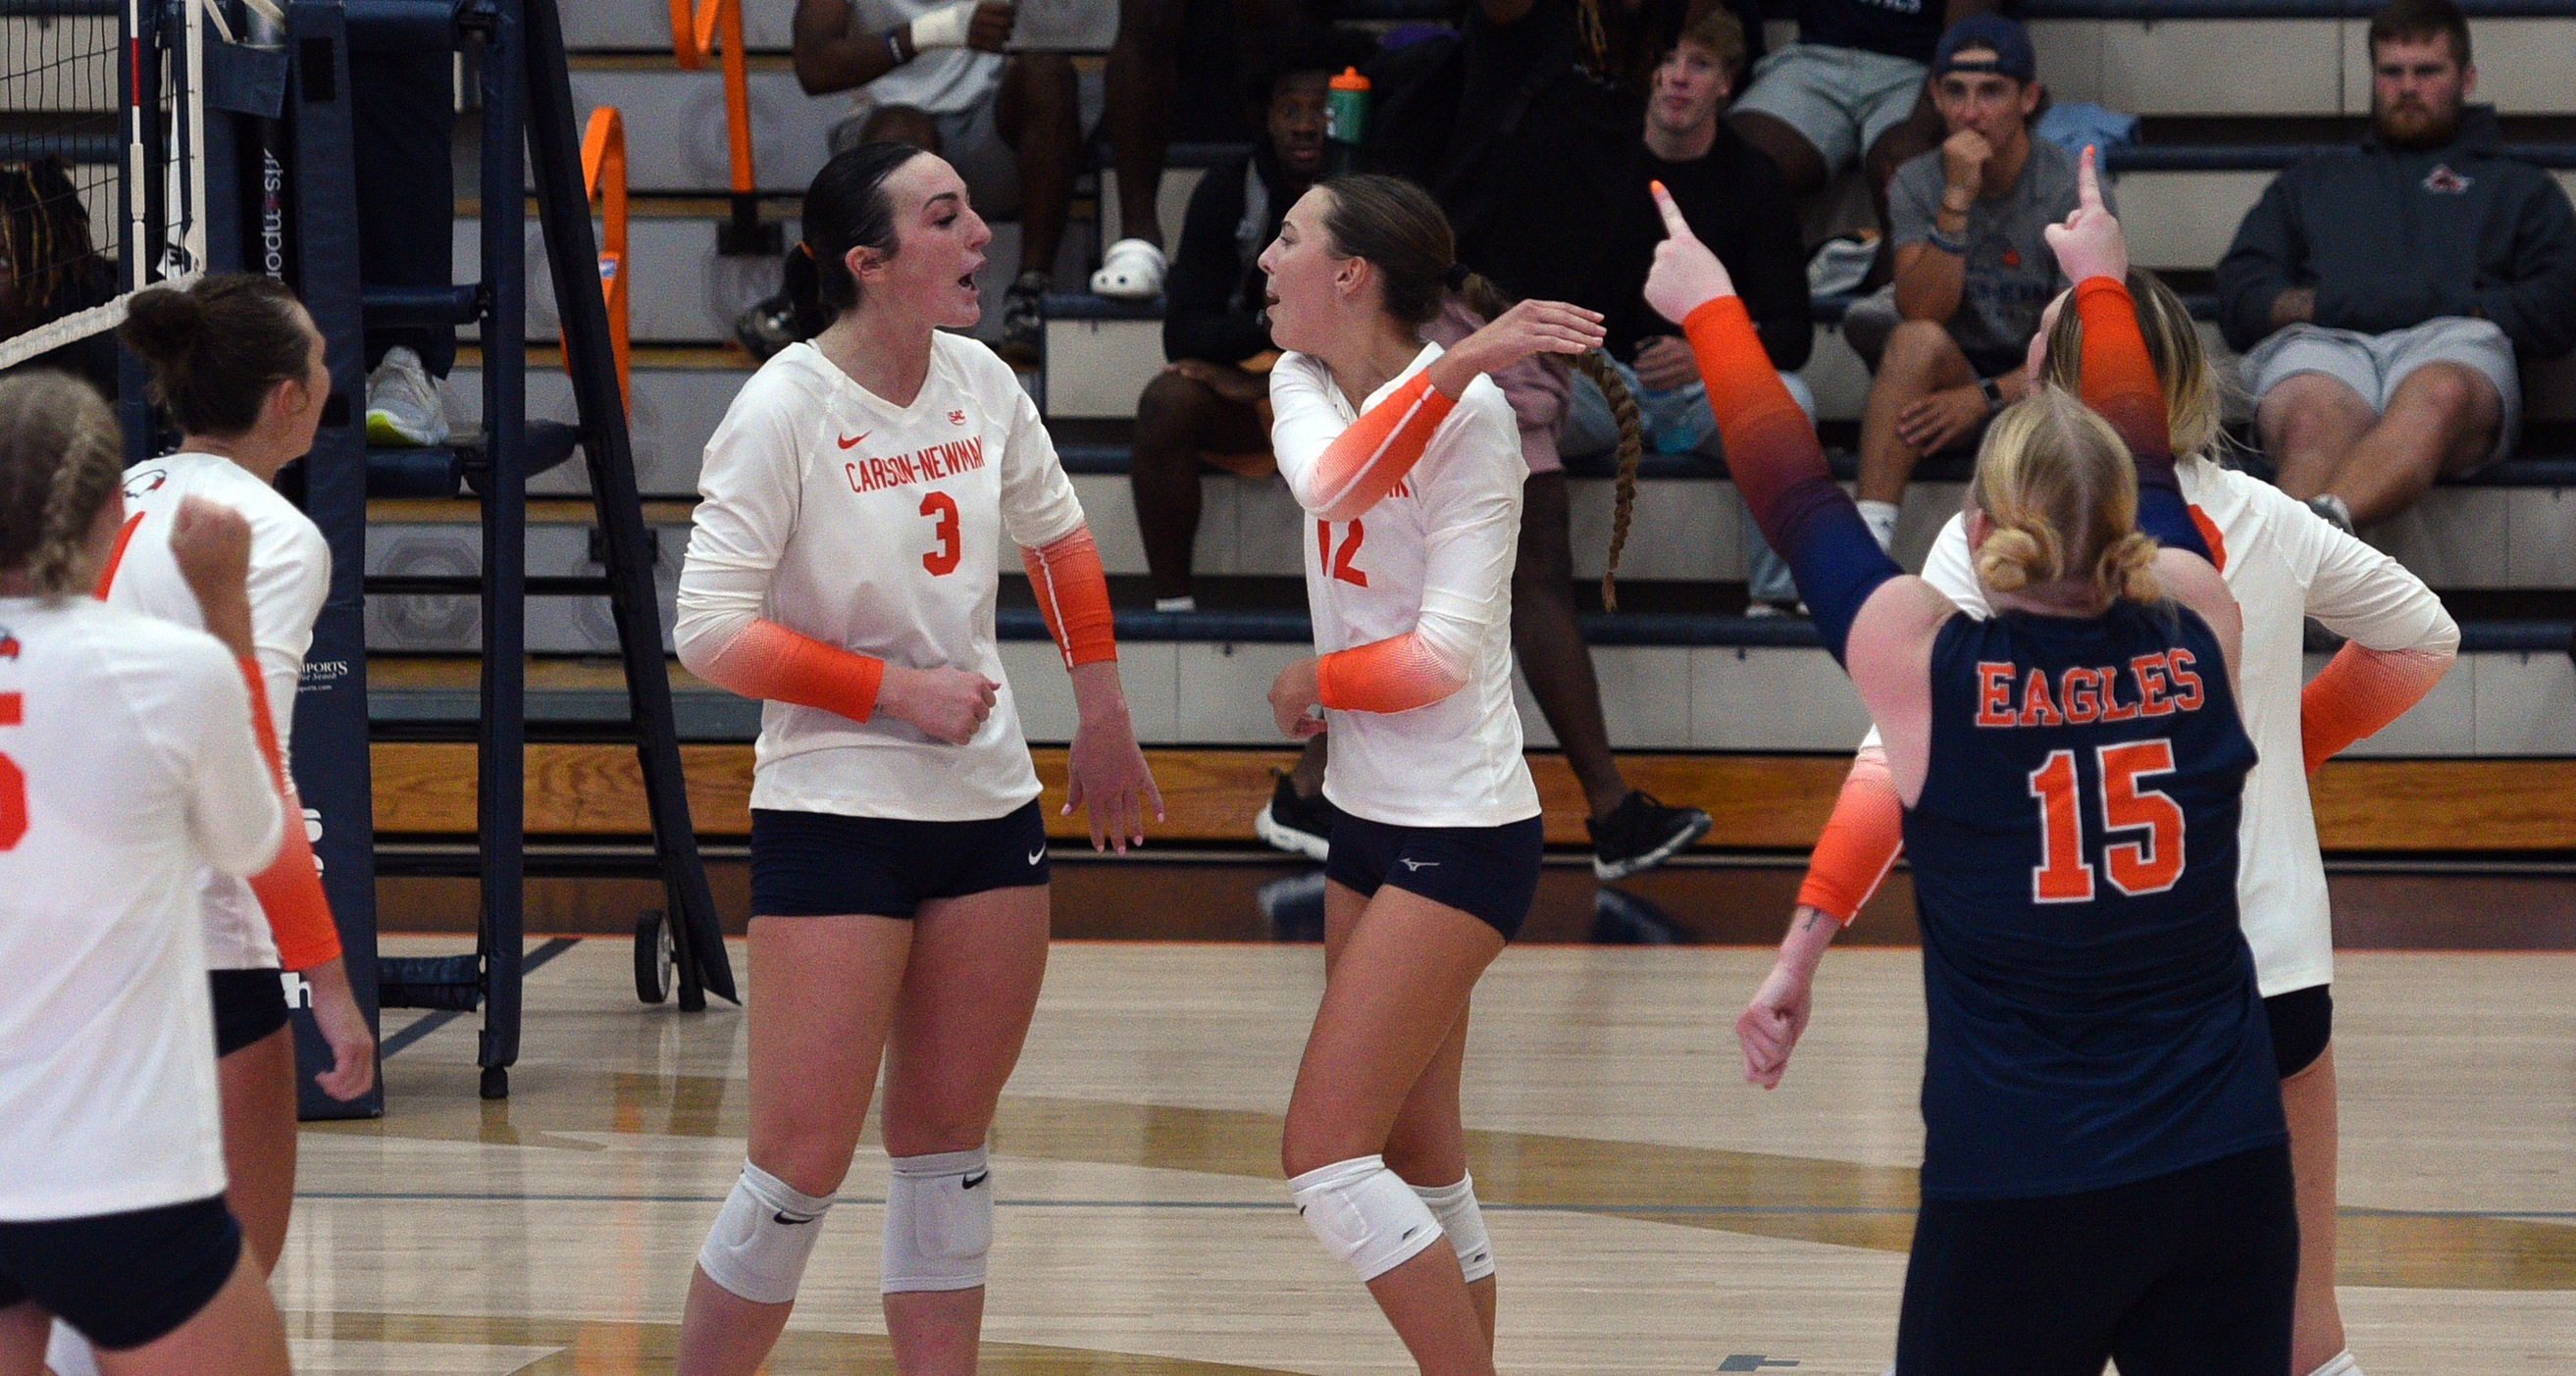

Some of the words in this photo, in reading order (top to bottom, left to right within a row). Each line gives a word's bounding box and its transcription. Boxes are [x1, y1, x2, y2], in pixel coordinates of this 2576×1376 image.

[919, 490, 960, 577] 3
[301, 660, 348, 676] PORTS
[1975, 647, 2205, 727] EAGLES
[2028, 738, 2187, 903] 15
